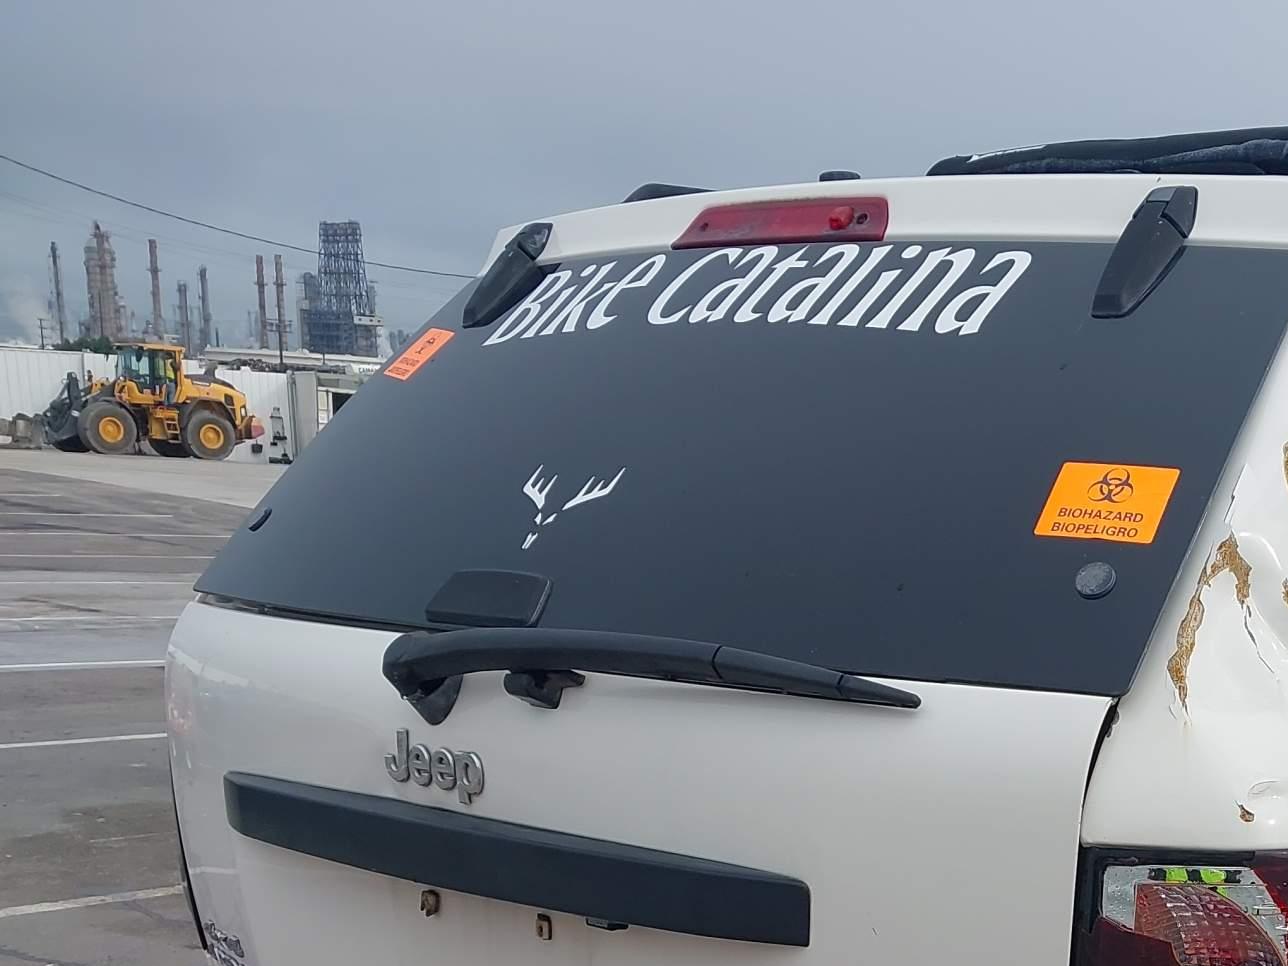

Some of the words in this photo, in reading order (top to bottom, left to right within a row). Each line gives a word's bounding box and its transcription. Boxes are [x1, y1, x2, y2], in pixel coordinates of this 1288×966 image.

[481, 253, 667, 347] Bike
[646, 244, 1032, 336] Catalina
[1051, 521, 1139, 538] BIOPELIGRO
[1057, 507, 1144, 523] BIOHAZARD
[384, 728, 486, 805] Jeep
